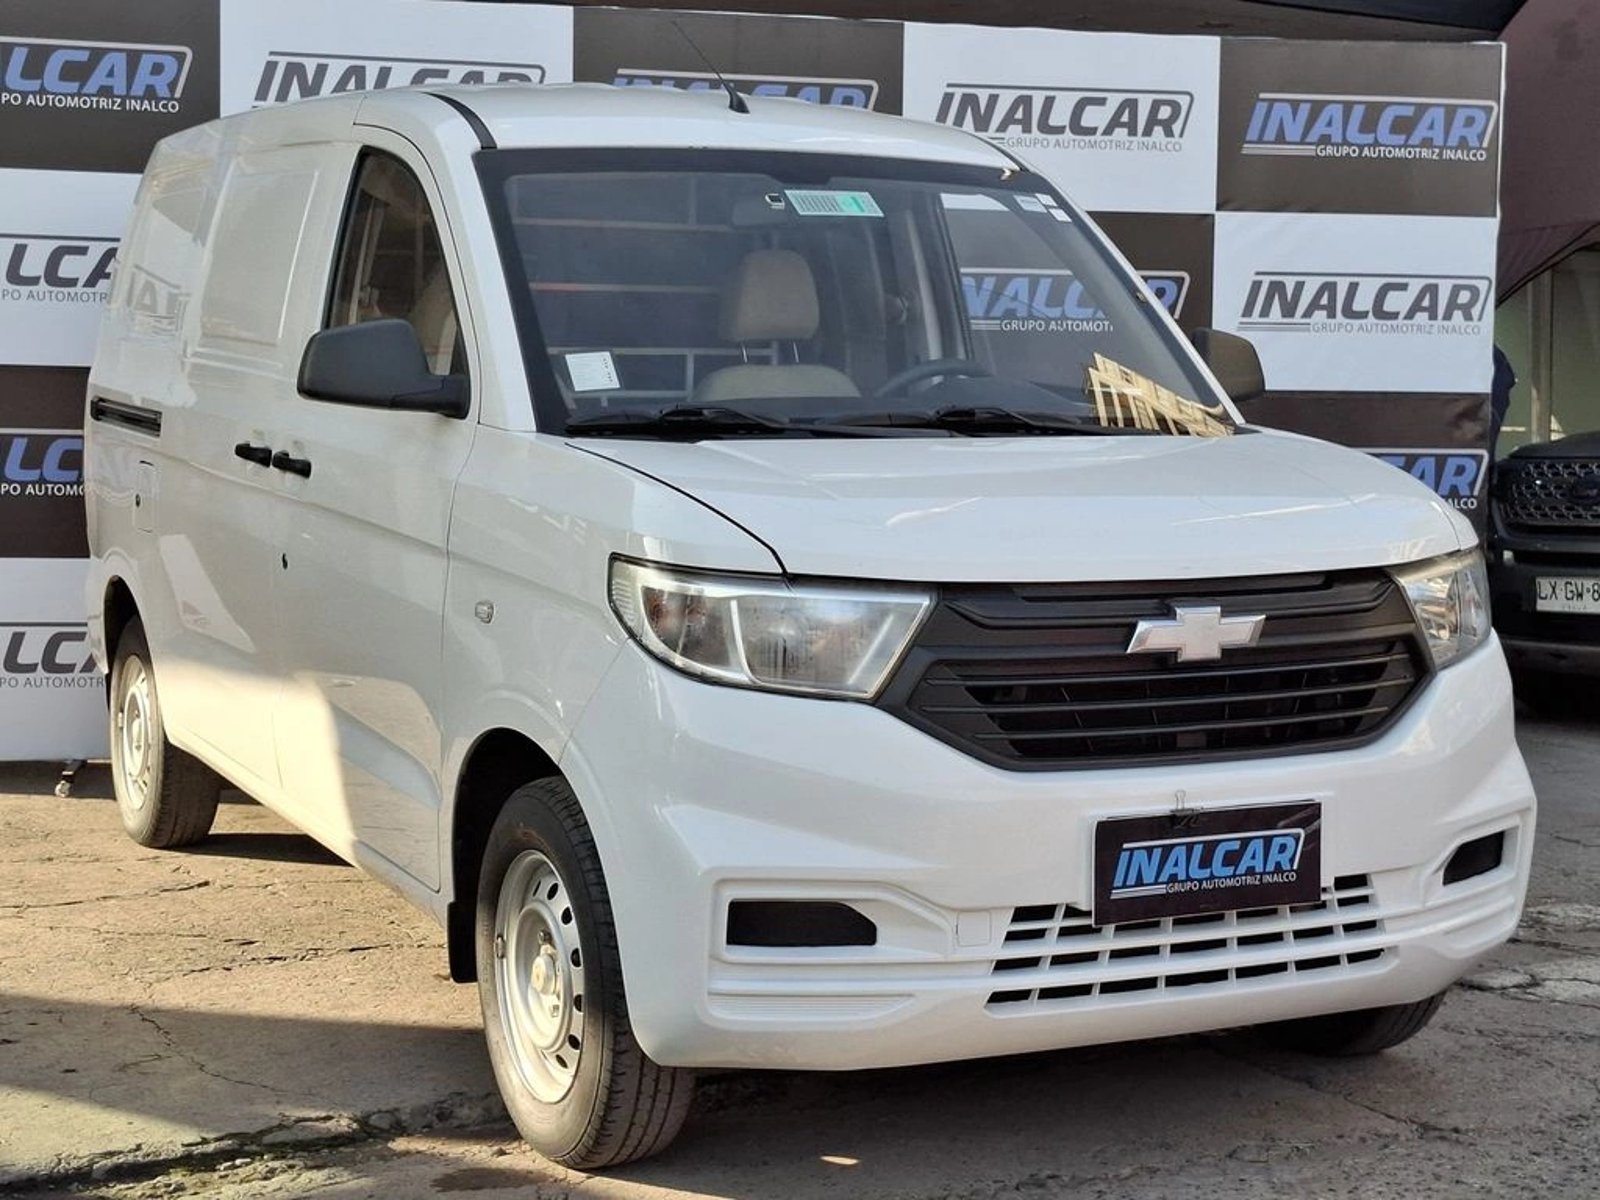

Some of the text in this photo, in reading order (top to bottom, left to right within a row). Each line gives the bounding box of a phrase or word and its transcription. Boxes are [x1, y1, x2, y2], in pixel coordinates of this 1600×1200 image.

[5, 46, 179, 98] LCAR
[26, 94, 121, 110] AUTOMOTRIZ
[126, 99, 180, 113] INALCO
[935, 91, 1182, 138] INALCAR
[1245, 100, 1487, 147] INALCAR
[1007, 137, 1182, 152] GRUPO AUTOMOTRIZ INALCO
[1317, 145, 1487, 162] GRUPO AUTOMOTRIZ INALCO
[1241, 280, 1481, 322] INALCAR
[1002, 319, 1113, 332] GRUPO AUTOMOT
[1312, 322, 1481, 336] GRUPO AUTOMOTRIZ INALCO
[1113, 836, 1297, 888] INALCAR
[1166, 871, 1297, 894] GRUPO AUTOMOTRIZ INALCO
